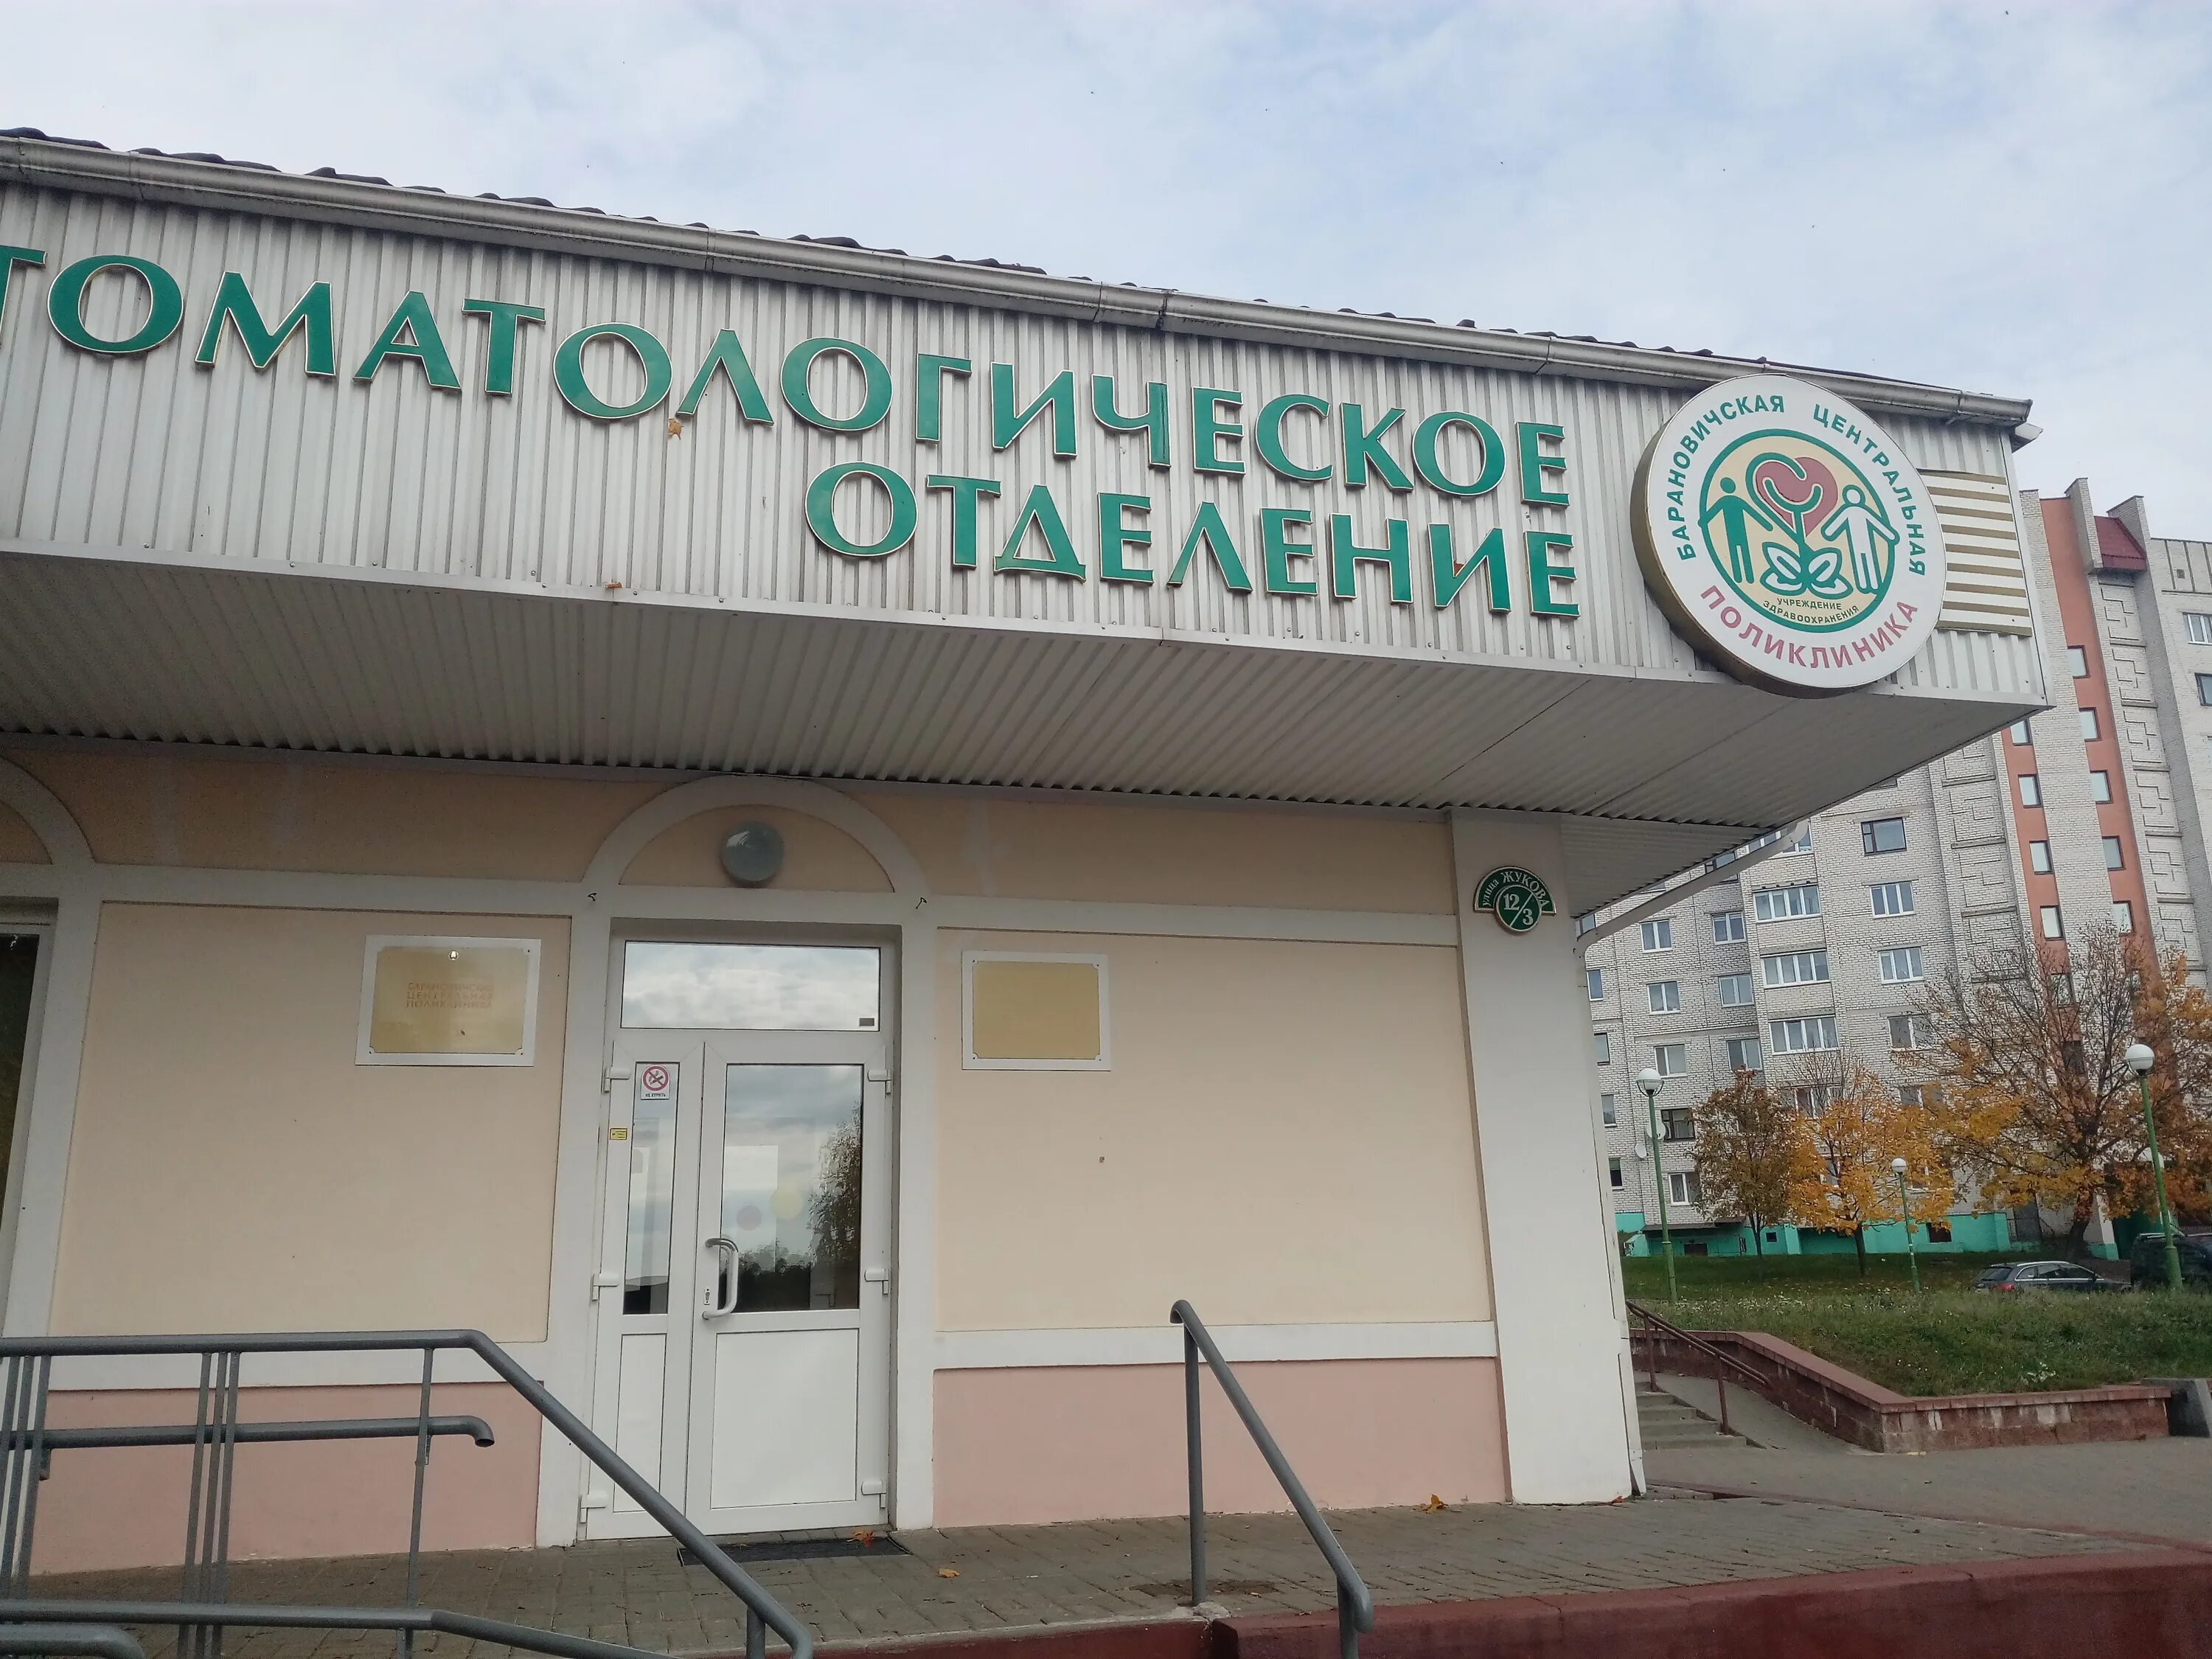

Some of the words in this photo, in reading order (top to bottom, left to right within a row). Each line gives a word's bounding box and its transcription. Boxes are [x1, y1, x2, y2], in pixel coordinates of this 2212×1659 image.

[1664, 394, 1785, 561] БАРАНОВИЧСКАЯ
[1813, 403, 1926, 577] ЦЕНТРАЛЬНАЯ
[804, 462, 1582, 617] ОТДЕЛЕНИЕ
[1700, 585, 1918, 669] ПОЛИКЛИНИКА
[1763, 600, 1860, 624] ЗДРАВООХРАНЕНИЯ
[1776, 597, 1842, 611] УЧРЕЖДЕНИЕ
[1500, 870, 1550, 908] ЖУКОВА
